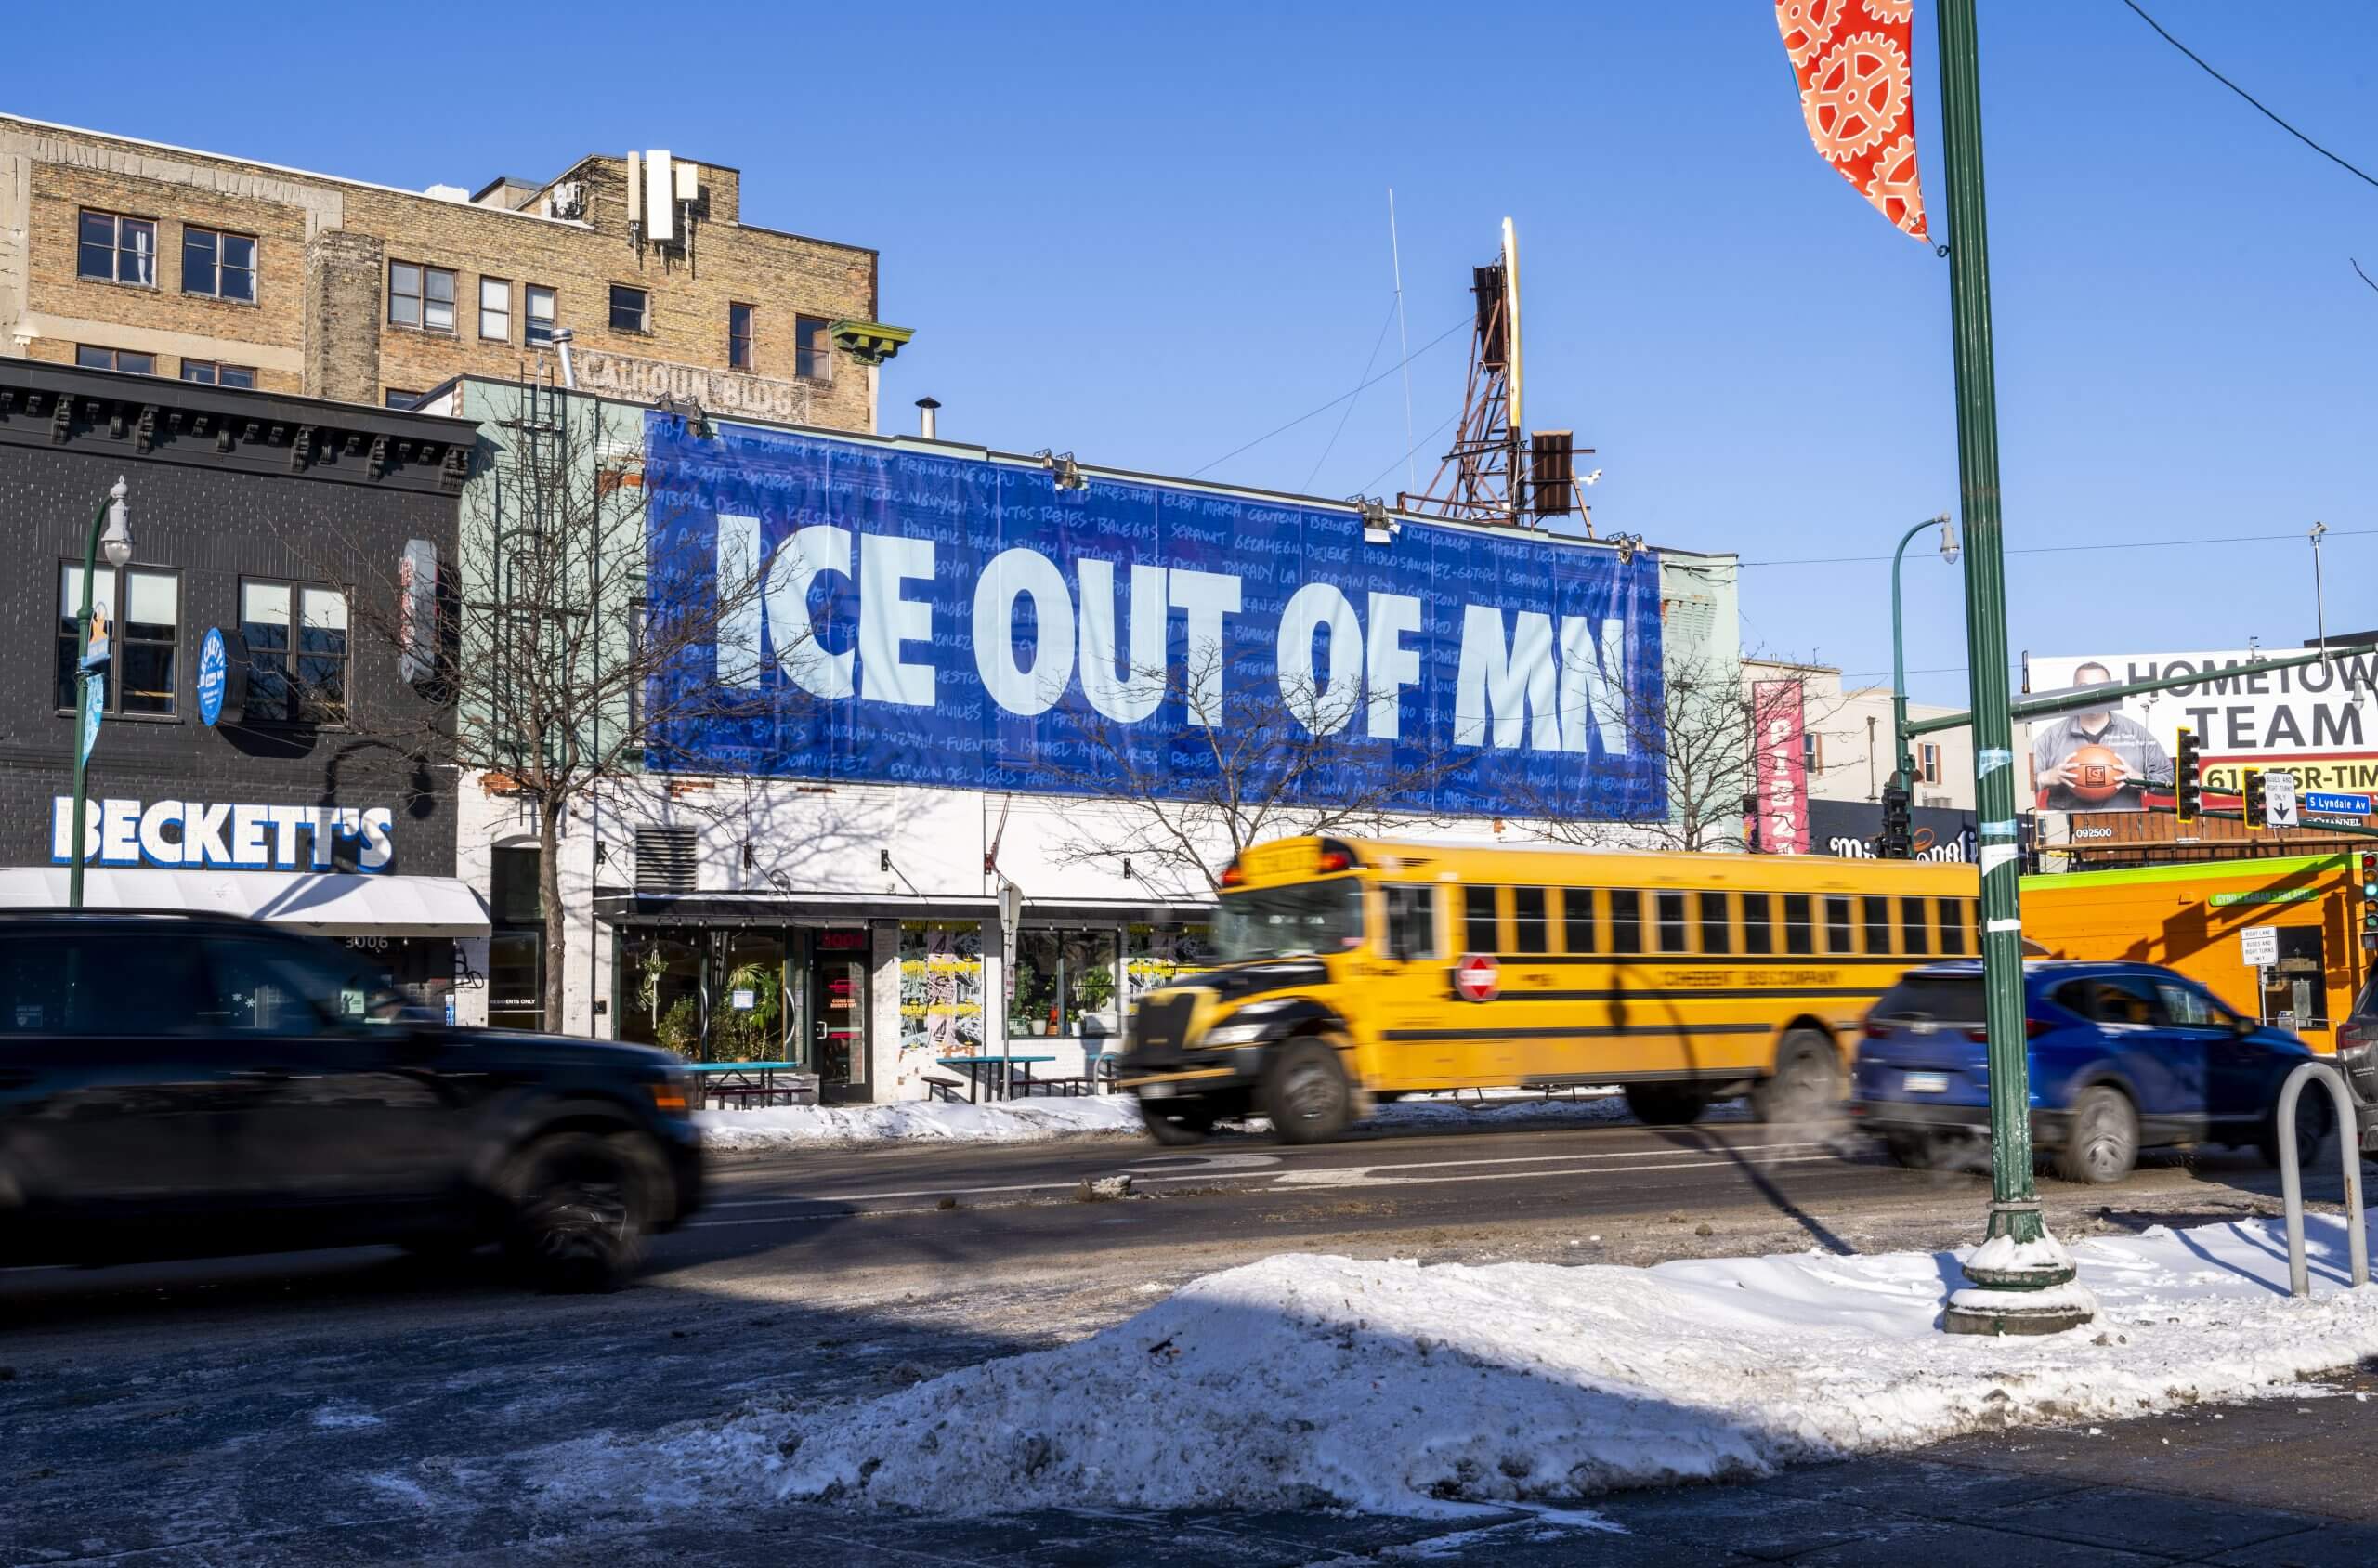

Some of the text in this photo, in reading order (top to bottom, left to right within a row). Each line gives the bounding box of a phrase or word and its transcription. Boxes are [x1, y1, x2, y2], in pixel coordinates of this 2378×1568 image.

[982, 503, 1033, 521] SANTOS
[717, 514, 1626, 755] ICE OUT OF MN
[2186, 702, 2363, 751] TEAM
[1170, 751, 1214, 769] RENEE
[946, 766, 973, 782] DEL
[974, 766, 1018, 784] JESUS
[2310, 797, 2366, 810] S Lyndale Av
[52, 795, 394, 872] BECKETT'S
[2076, 828, 2112, 838] 092500
[346, 936, 388, 949] 3006
